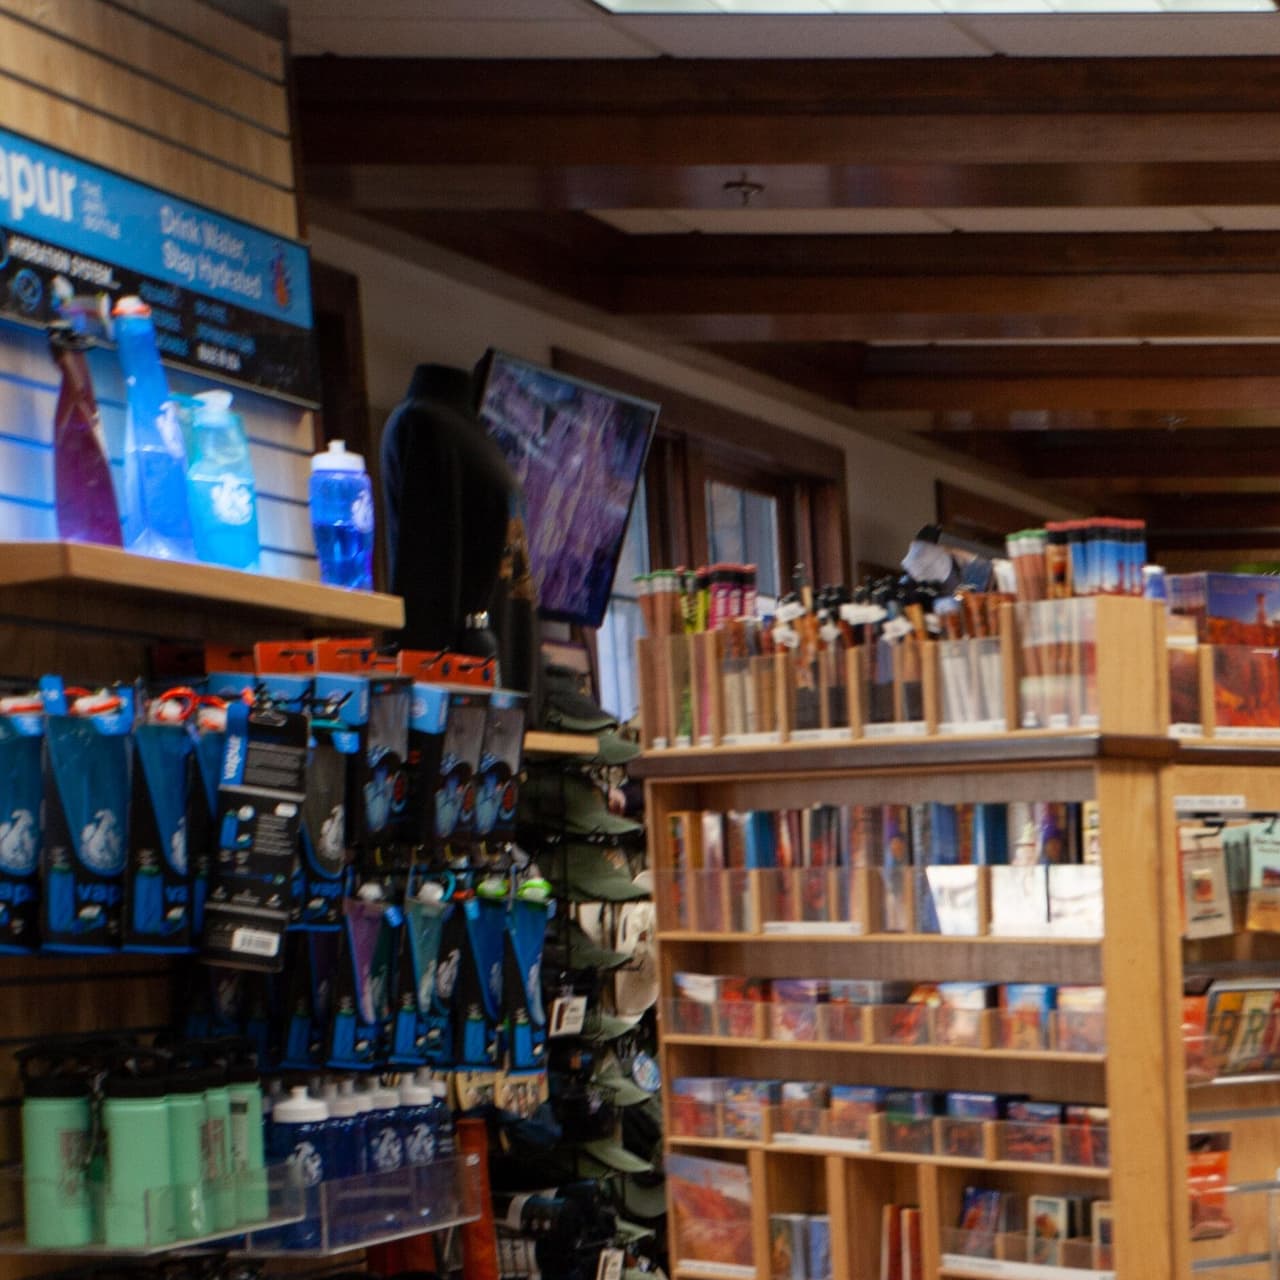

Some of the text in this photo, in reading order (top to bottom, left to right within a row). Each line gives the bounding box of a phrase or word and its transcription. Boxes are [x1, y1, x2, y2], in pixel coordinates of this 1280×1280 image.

[160, 205, 200, 243] Drink
[162, 240, 262, 299] Stay Hydrated
